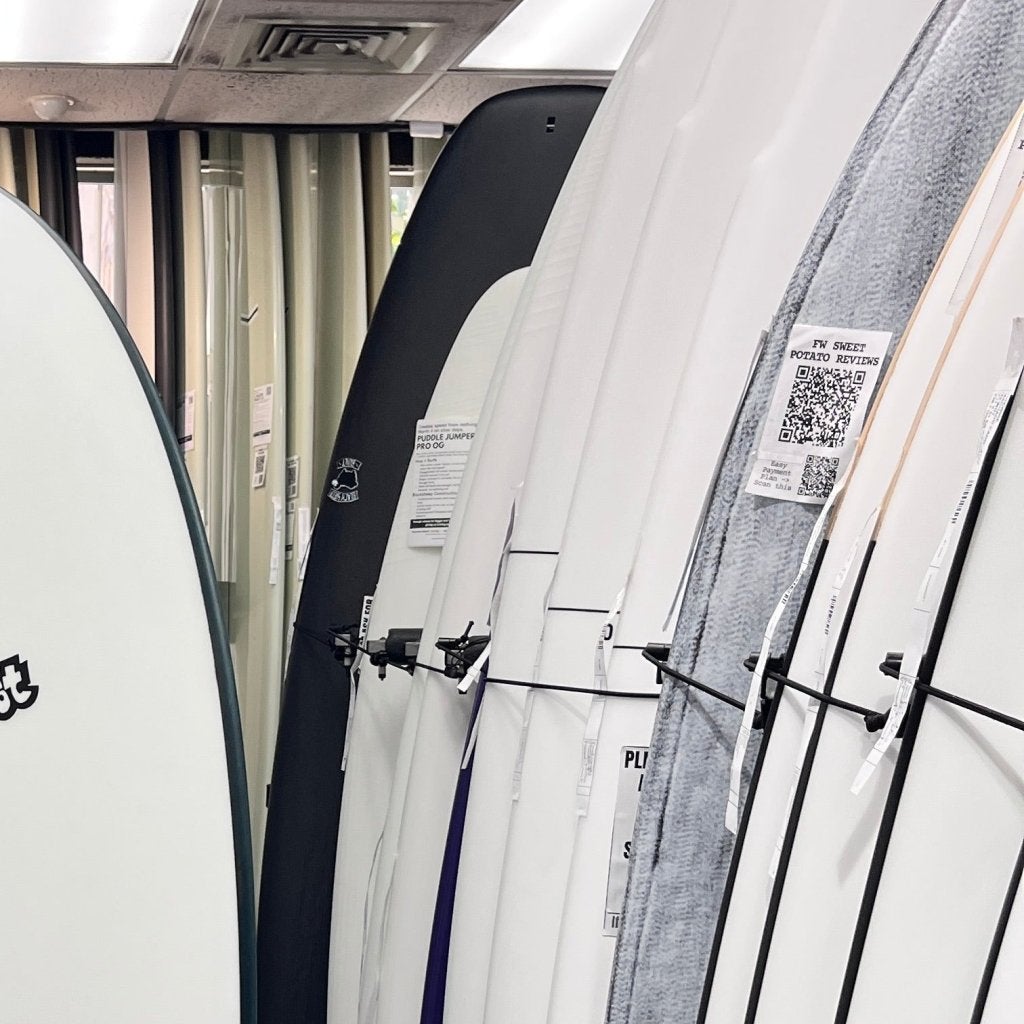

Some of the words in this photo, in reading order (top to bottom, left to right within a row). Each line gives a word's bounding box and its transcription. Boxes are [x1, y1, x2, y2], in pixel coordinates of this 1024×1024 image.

[812, 339, 828, 349] FW
[832, 341, 866, 352] SWEET
[790, 350, 831, 362] POTATO
[836, 354, 880, 366] REVIEWS
[417, 433, 444, 442] PUDDLE
[416, 442, 431, 450] PRO
[432, 441, 444, 449] OG
[770, 460, 788, 469] Easy
[762, 467, 792, 476] Payment
[760, 473, 778, 482] Plan
[775, 482, 792, 491] this
